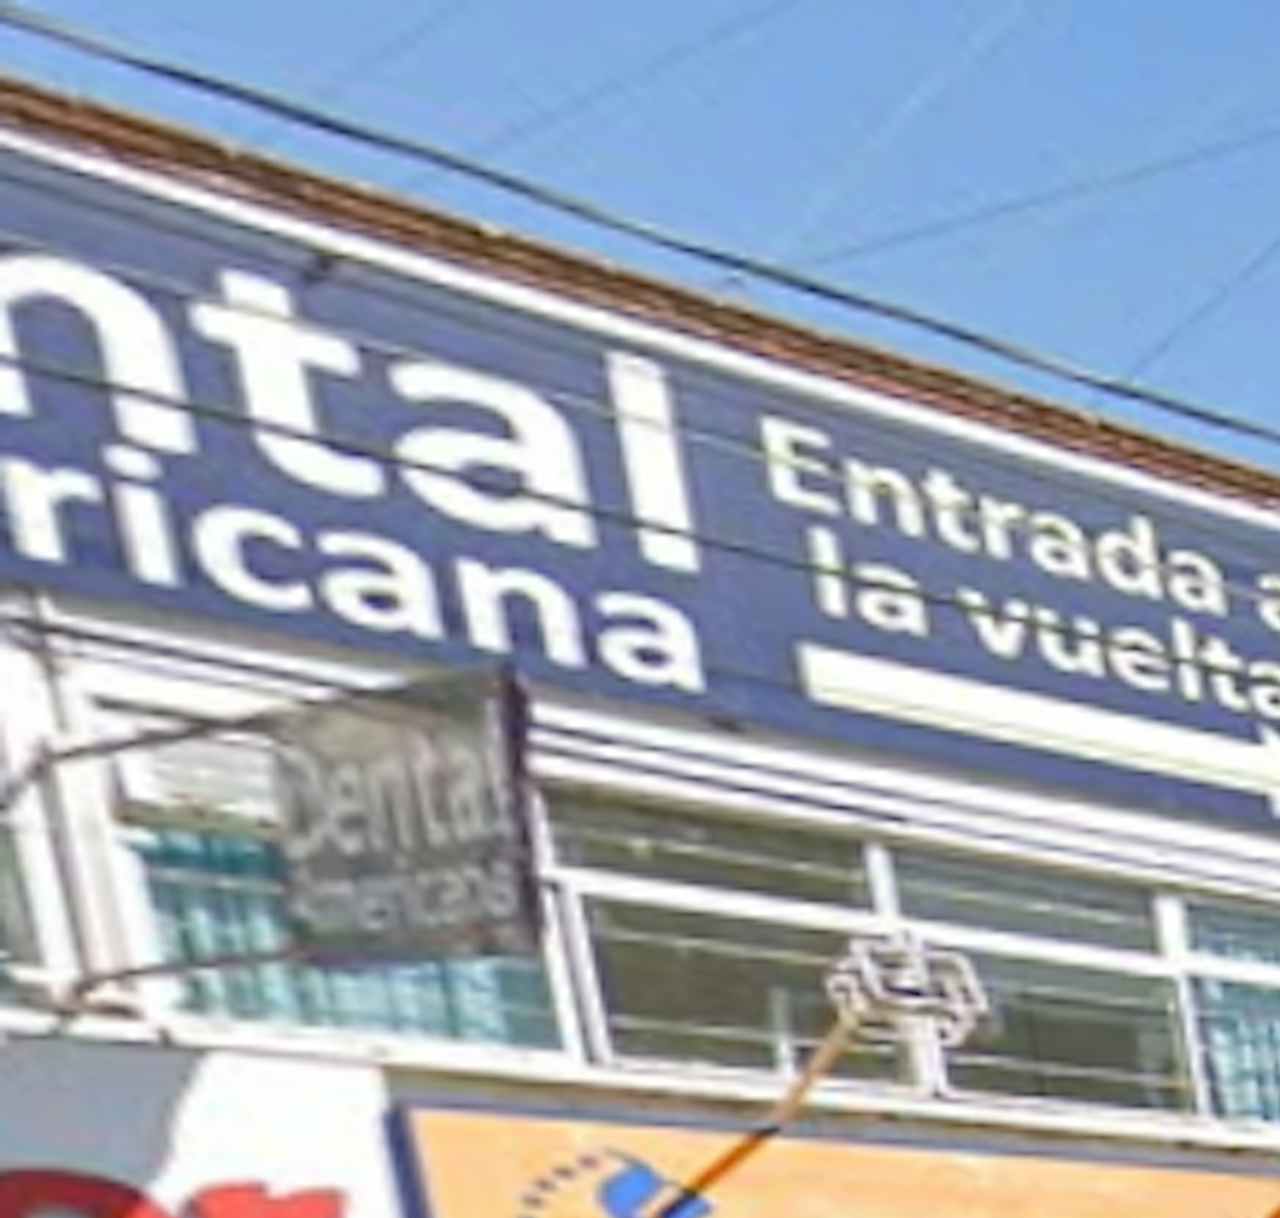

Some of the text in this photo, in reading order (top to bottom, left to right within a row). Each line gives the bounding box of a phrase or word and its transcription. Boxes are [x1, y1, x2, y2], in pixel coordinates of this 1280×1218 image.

[0, 252, 702, 574] ntal
[759, 413, 1229, 617] Entrada
[3, 443, 707, 694] ricana
[807, 526, 930, 639] la
